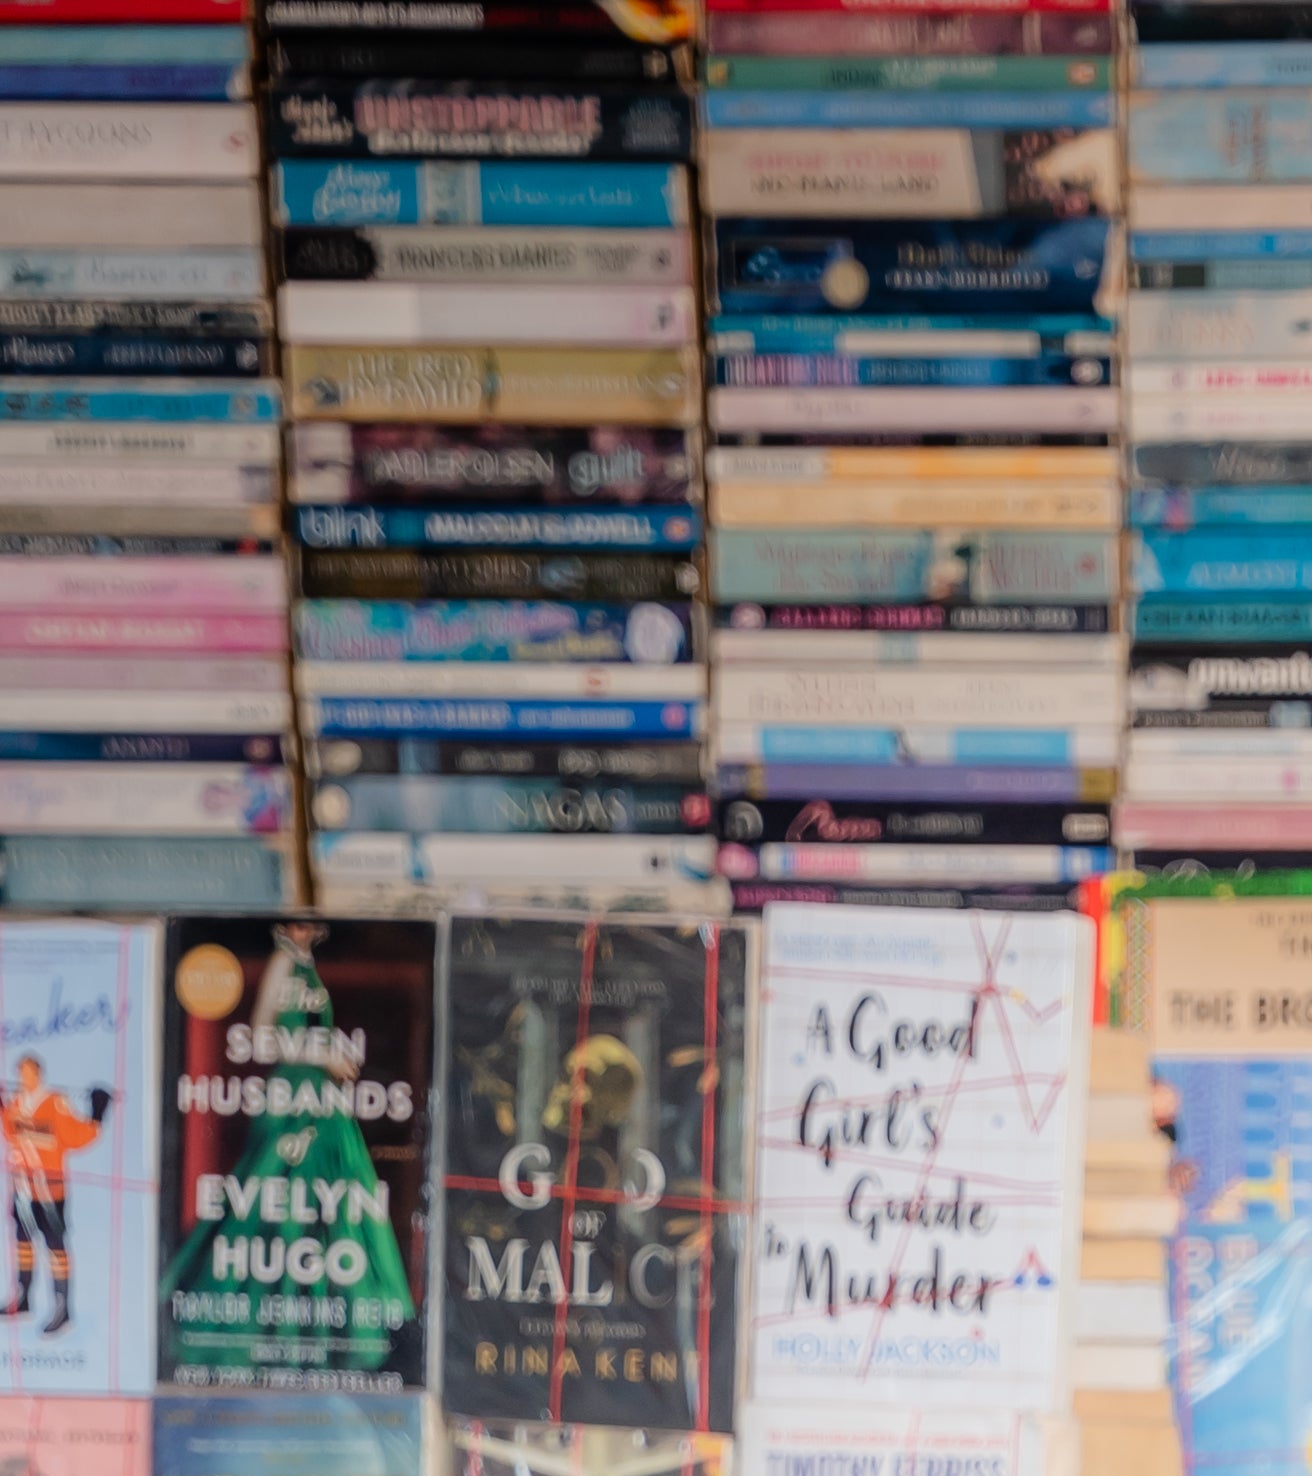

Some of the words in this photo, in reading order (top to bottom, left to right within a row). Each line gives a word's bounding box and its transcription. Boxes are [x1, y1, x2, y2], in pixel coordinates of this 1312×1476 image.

[808, 1005, 832, 1056] A
[848, 990, 980, 1069] Good
[1167, 990, 1236, 1030] THE
[225, 1022, 367, 1066] SEVEN
[177, 1073, 414, 1123] HUSBANDS
[798, 1078, 942, 1167] Girl's
[195, 1174, 391, 1225] EVELYN
[846, 1176, 998, 1243] Guide
[211, 1235, 368, 1287] HUGO
[782, 1245, 1000, 1320] Murder
[257, 1294, 348, 1329] JENKINS
[352, 1297, 405, 1331] REID
[475, 1339, 581, 1379] RINA
[594, 1345, 702, 1385] KEN
[868, 1338, 1003, 1368] JACKSON
